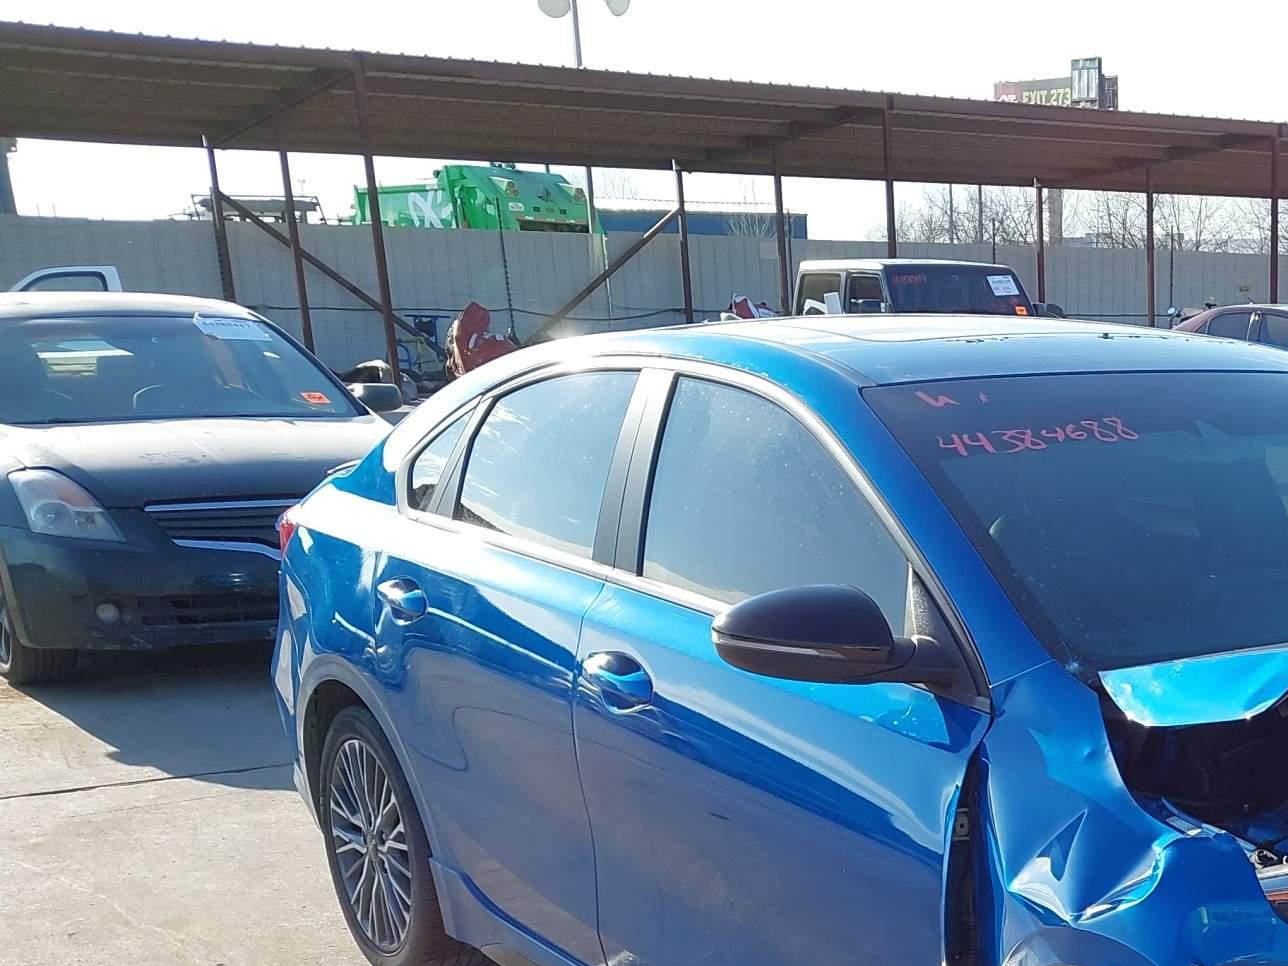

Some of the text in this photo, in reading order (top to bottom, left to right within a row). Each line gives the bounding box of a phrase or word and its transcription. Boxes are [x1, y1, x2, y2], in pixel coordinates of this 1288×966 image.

[1023, 90, 1048, 105] EXIT
[1050, 87, 1072, 107] 273
[937, 416, 1139, 456] 44384688
